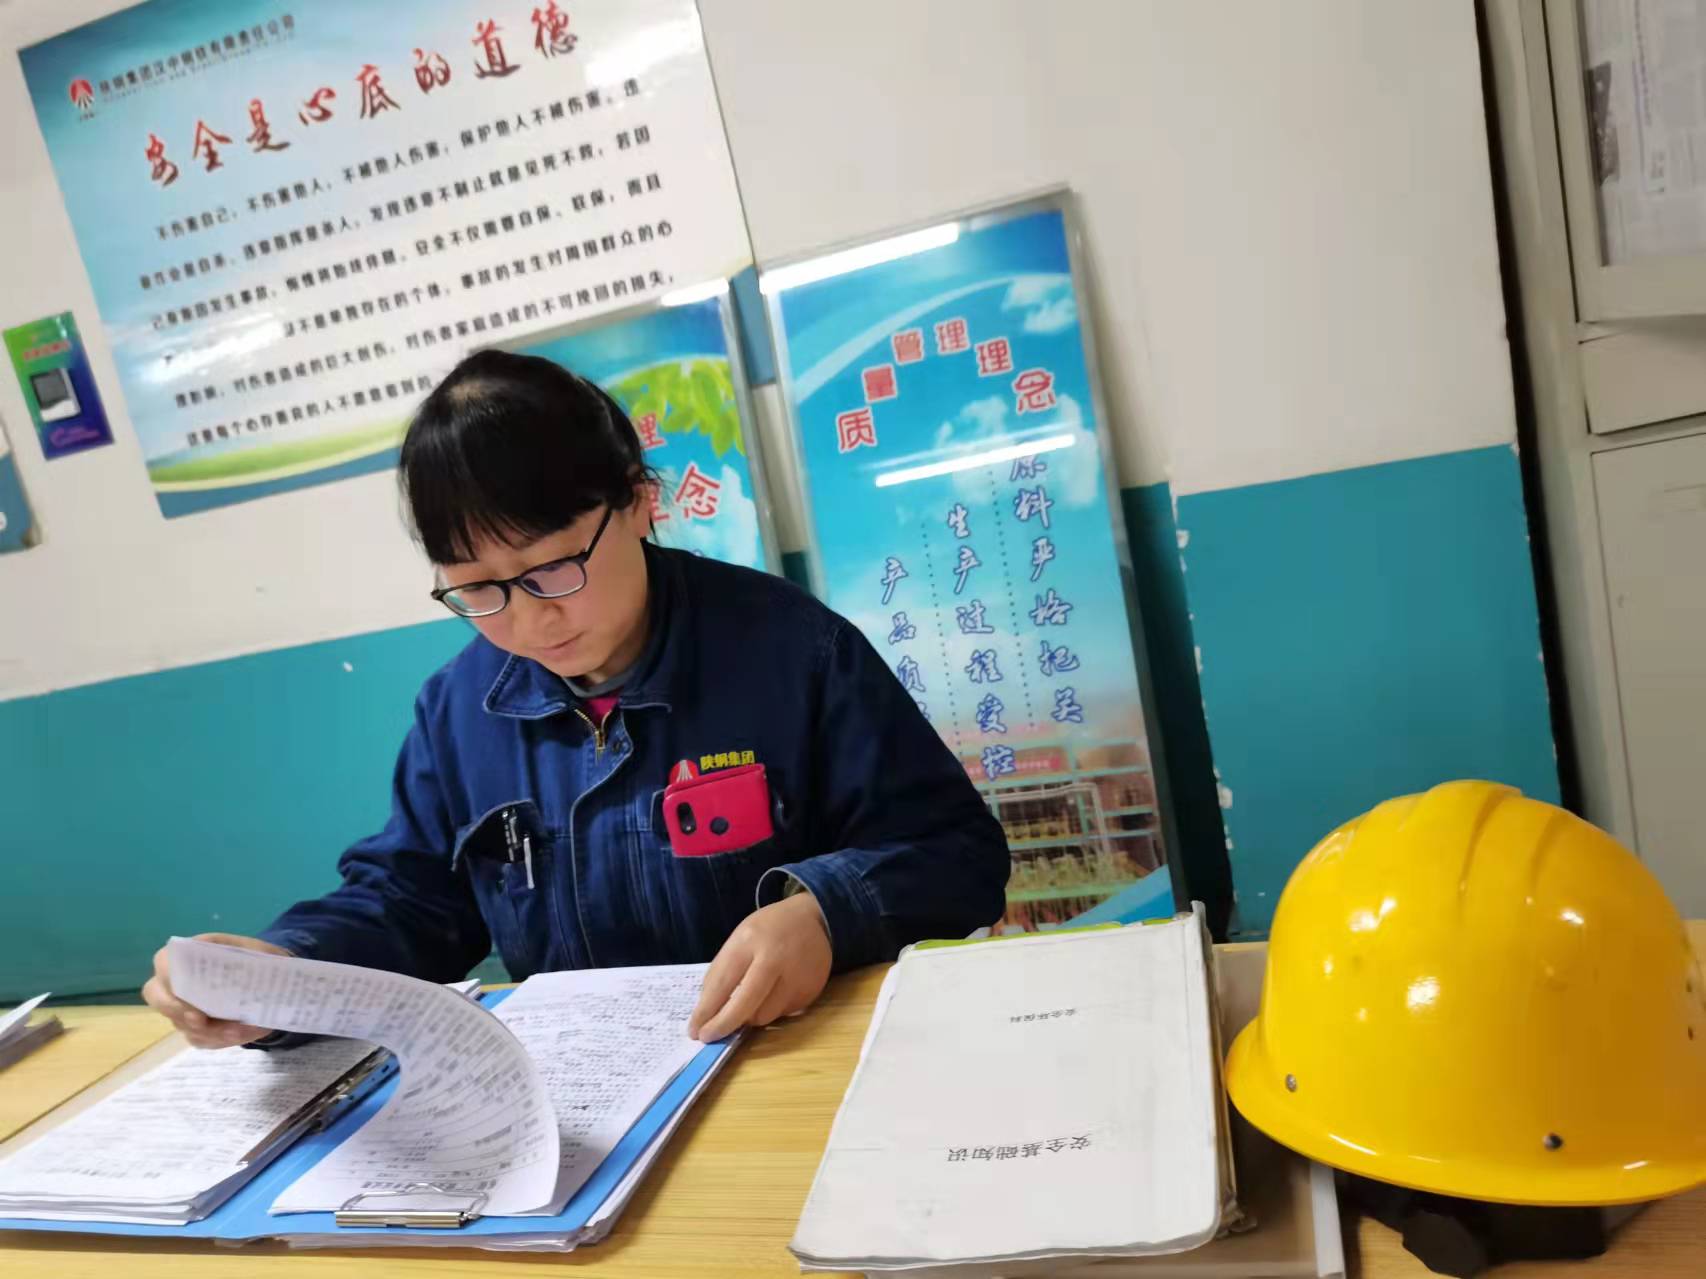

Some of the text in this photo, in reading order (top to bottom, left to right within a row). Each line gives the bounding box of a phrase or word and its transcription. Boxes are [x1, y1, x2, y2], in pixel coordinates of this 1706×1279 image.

[145, 0, 580, 186] 安全是心底的道德
[836, 318, 1057, 453] 质量管理理念
[881, 556, 930, 720] 产品质
[946, 503, 1017, 782] 生产过程受控
[946, 1133, 1092, 1164] 安全基础知识
